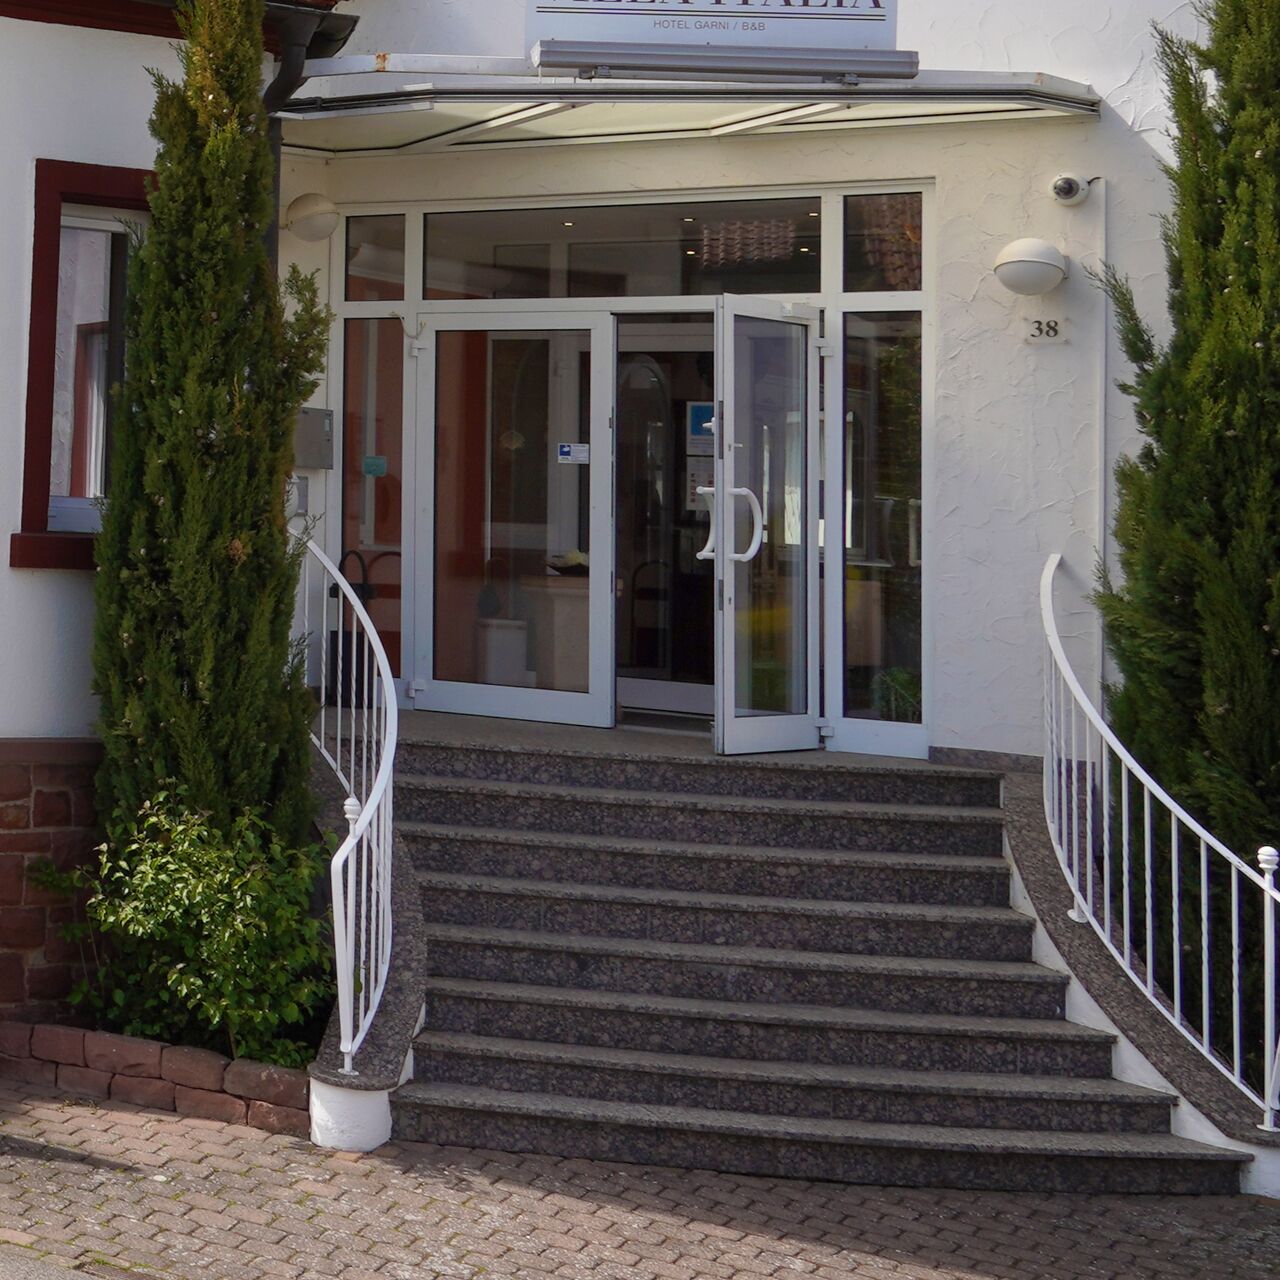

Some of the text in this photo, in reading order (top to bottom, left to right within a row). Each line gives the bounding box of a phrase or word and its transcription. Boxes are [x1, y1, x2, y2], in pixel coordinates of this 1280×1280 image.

[653, 19, 766, 31] HOTEL GARNI / B&B
[1030, 320, 1059, 338] 38
